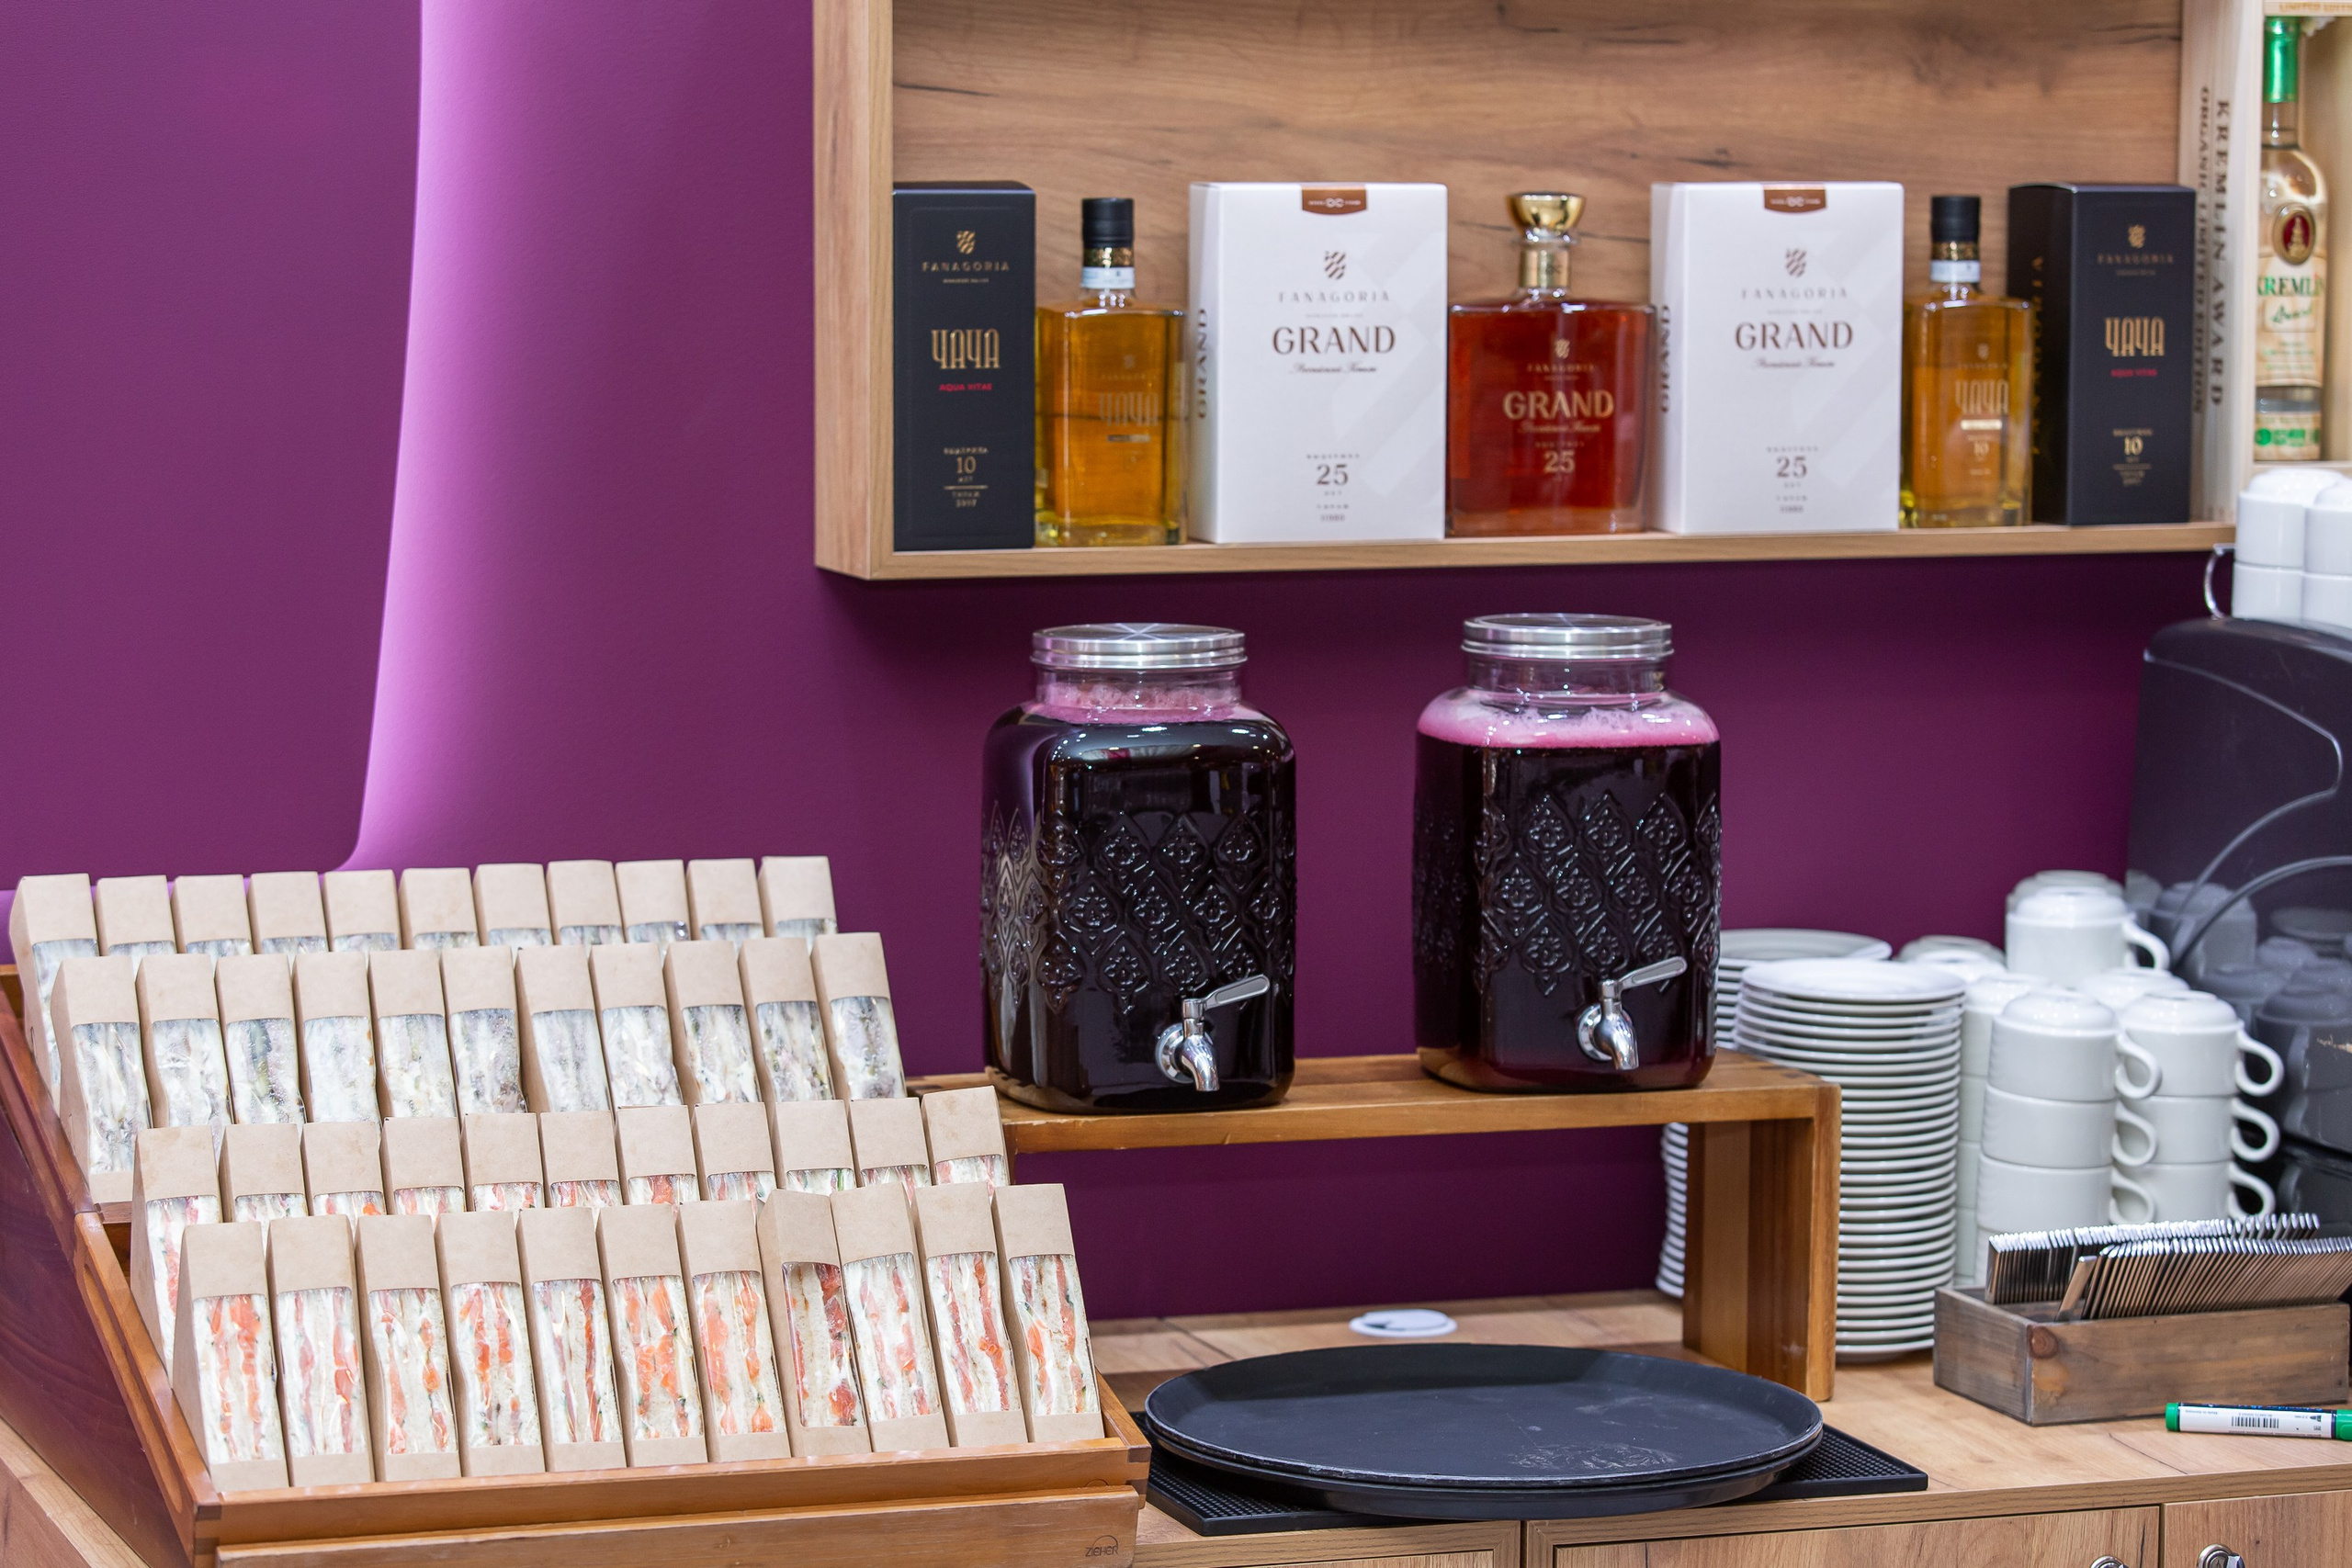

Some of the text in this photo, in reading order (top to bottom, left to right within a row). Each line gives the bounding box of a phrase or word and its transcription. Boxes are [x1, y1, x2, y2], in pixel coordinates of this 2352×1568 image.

[2211, 99, 2230, 406] KREMLIN AWARD
[922, 261, 1010, 272] FANAGORIA
[1278, 290, 1390, 303] FANAGORIA
[1741, 288, 1849, 299] FANAGORIA
[931, 328, 1001, 369] ЧАЧА
[1272, 325, 1396, 356] GRAND
[1735, 321, 1854, 352] GRAND
[2105, 316, 2165, 357] ЧАЧА
[1502, 389, 1614, 420] GRAND
[2124, 436, 2143, 456] 10
[956, 456, 977, 474] 10
[1544, 450, 1576, 474] 25
[1775, 455, 1807, 479] 25
[1316, 463, 1349, 486] 25
[1085, 1545, 1119, 1558] ZIEHER
